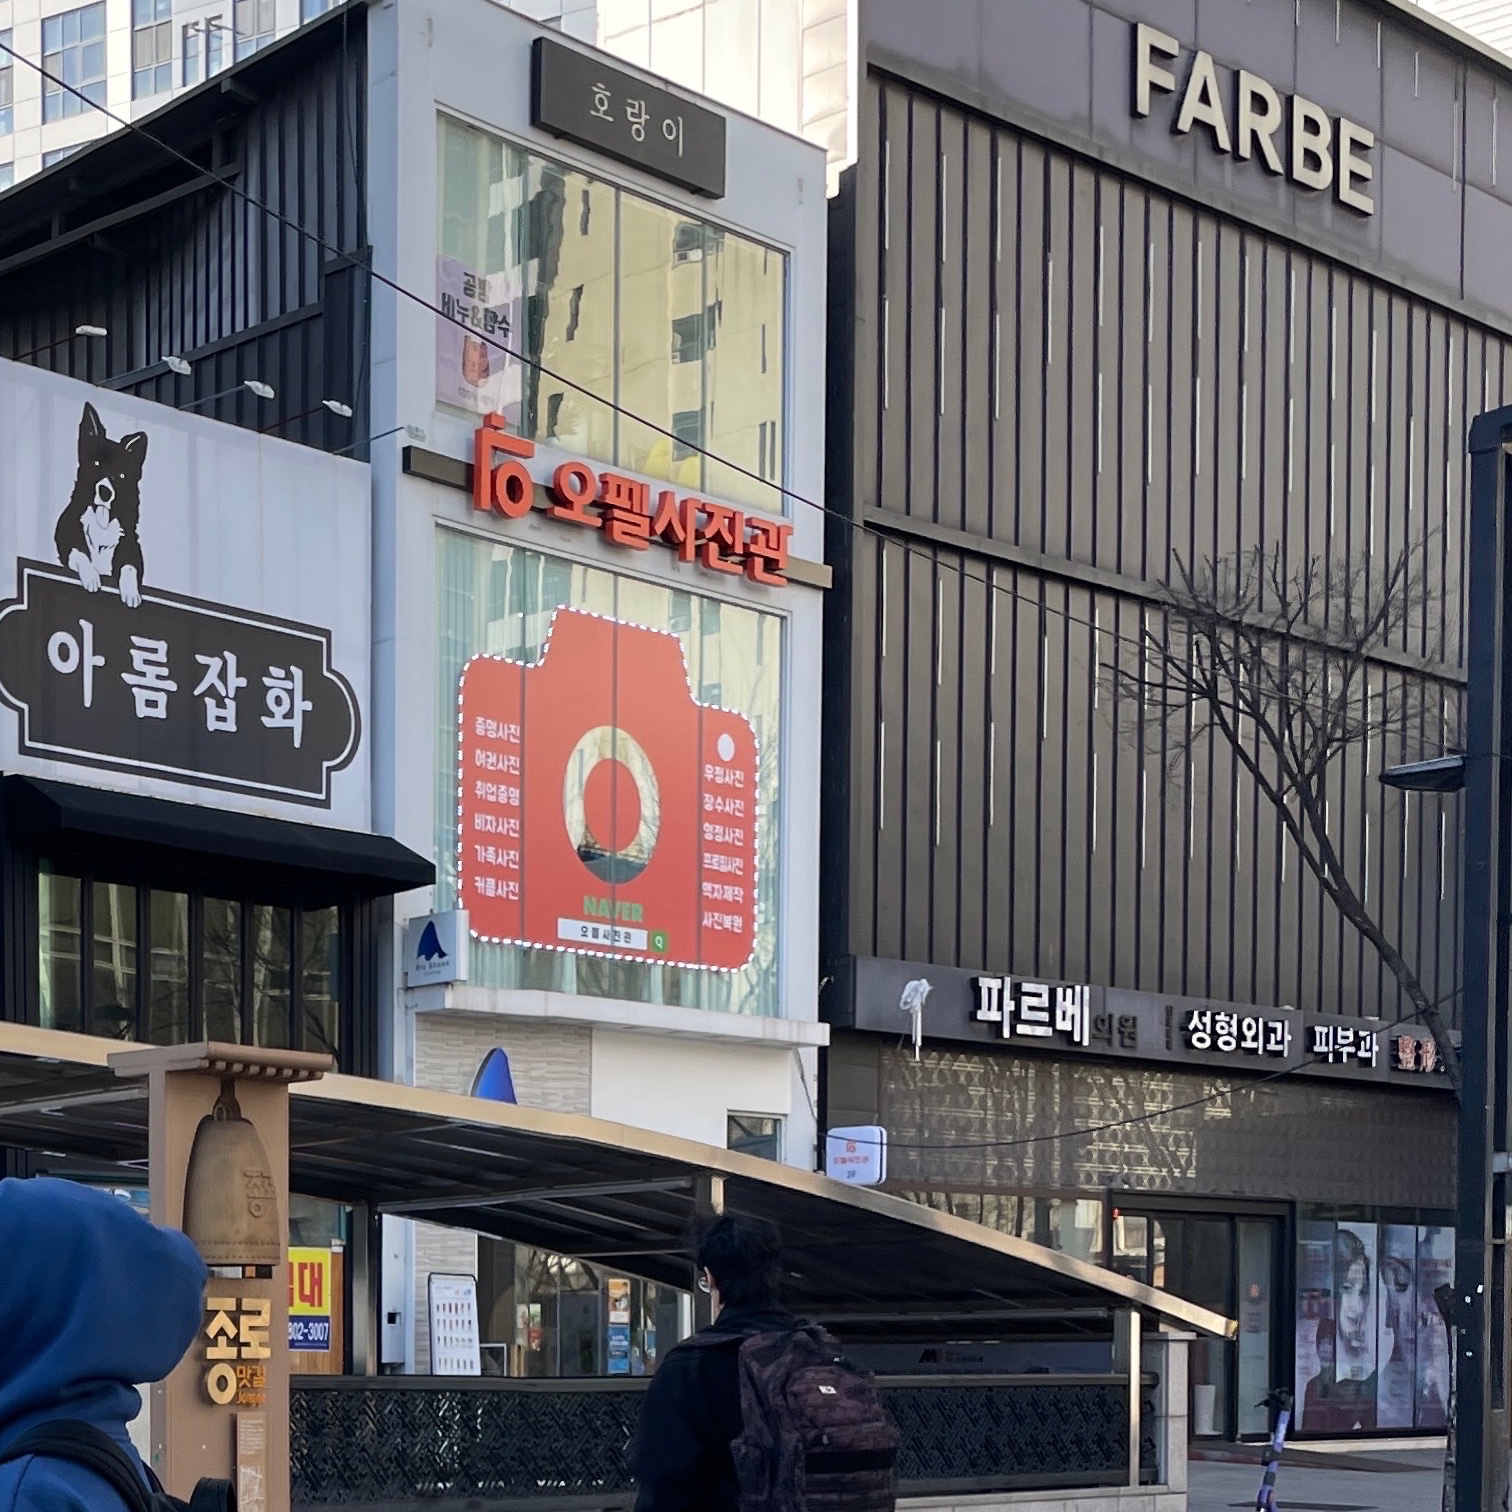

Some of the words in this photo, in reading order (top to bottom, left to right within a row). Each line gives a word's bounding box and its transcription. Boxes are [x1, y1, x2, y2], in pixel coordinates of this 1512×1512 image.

[588, 81, 685, 158] 호랑이
[1134, 22, 1375, 216] FARBE
[546, 461, 794, 588] 오펠사진관
[47, 618, 315, 750] 아롬잡화
[474, 716, 520, 743] 증명사진
[474, 749, 520, 775] 여권사진
[704, 764, 744, 788] 우정사진
[474, 780, 520, 806] 취업증명
[703, 793, 744, 817] 장수사진
[474, 813, 520, 838] 비자사진
[474, 845, 519, 869] 가족사진
[474, 876, 519, 900] 커플사진
[583, 895, 643, 923] NAVER
[976, 976, 1090, 1046] 파르베
[1091, 1013, 1138, 1049] 의원
[1188, 1010, 1292, 1057] 성형외과
[1313, 1025, 1380, 1067] 피부과
